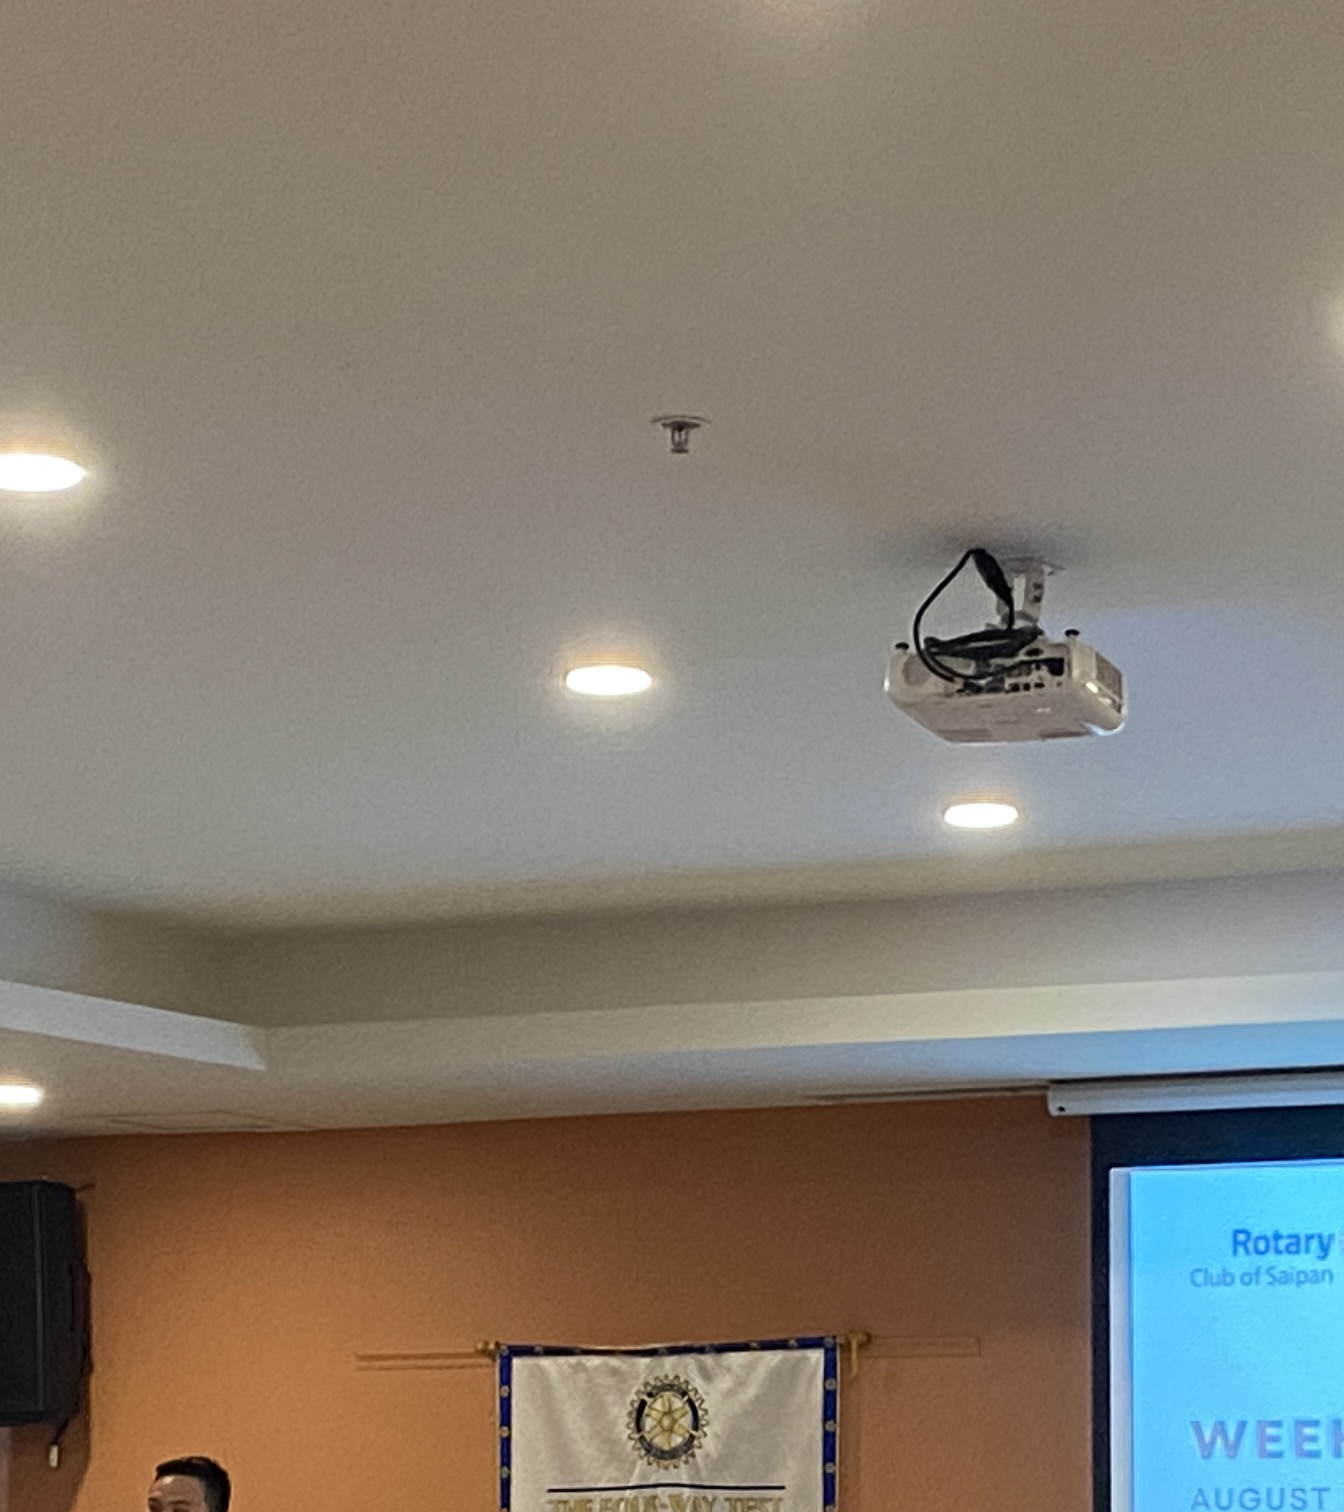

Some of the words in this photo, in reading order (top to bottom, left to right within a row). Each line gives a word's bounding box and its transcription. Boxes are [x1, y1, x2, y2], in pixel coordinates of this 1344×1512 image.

[1231, 1227, 1336, 1261] Rotary
[1189, 1266, 1235, 1288] Club
[1239, 1266, 1261, 1286] of
[1265, 1265, 1334, 1289] Saipan
[1190, 1486, 1331, 1512] AUGUST
